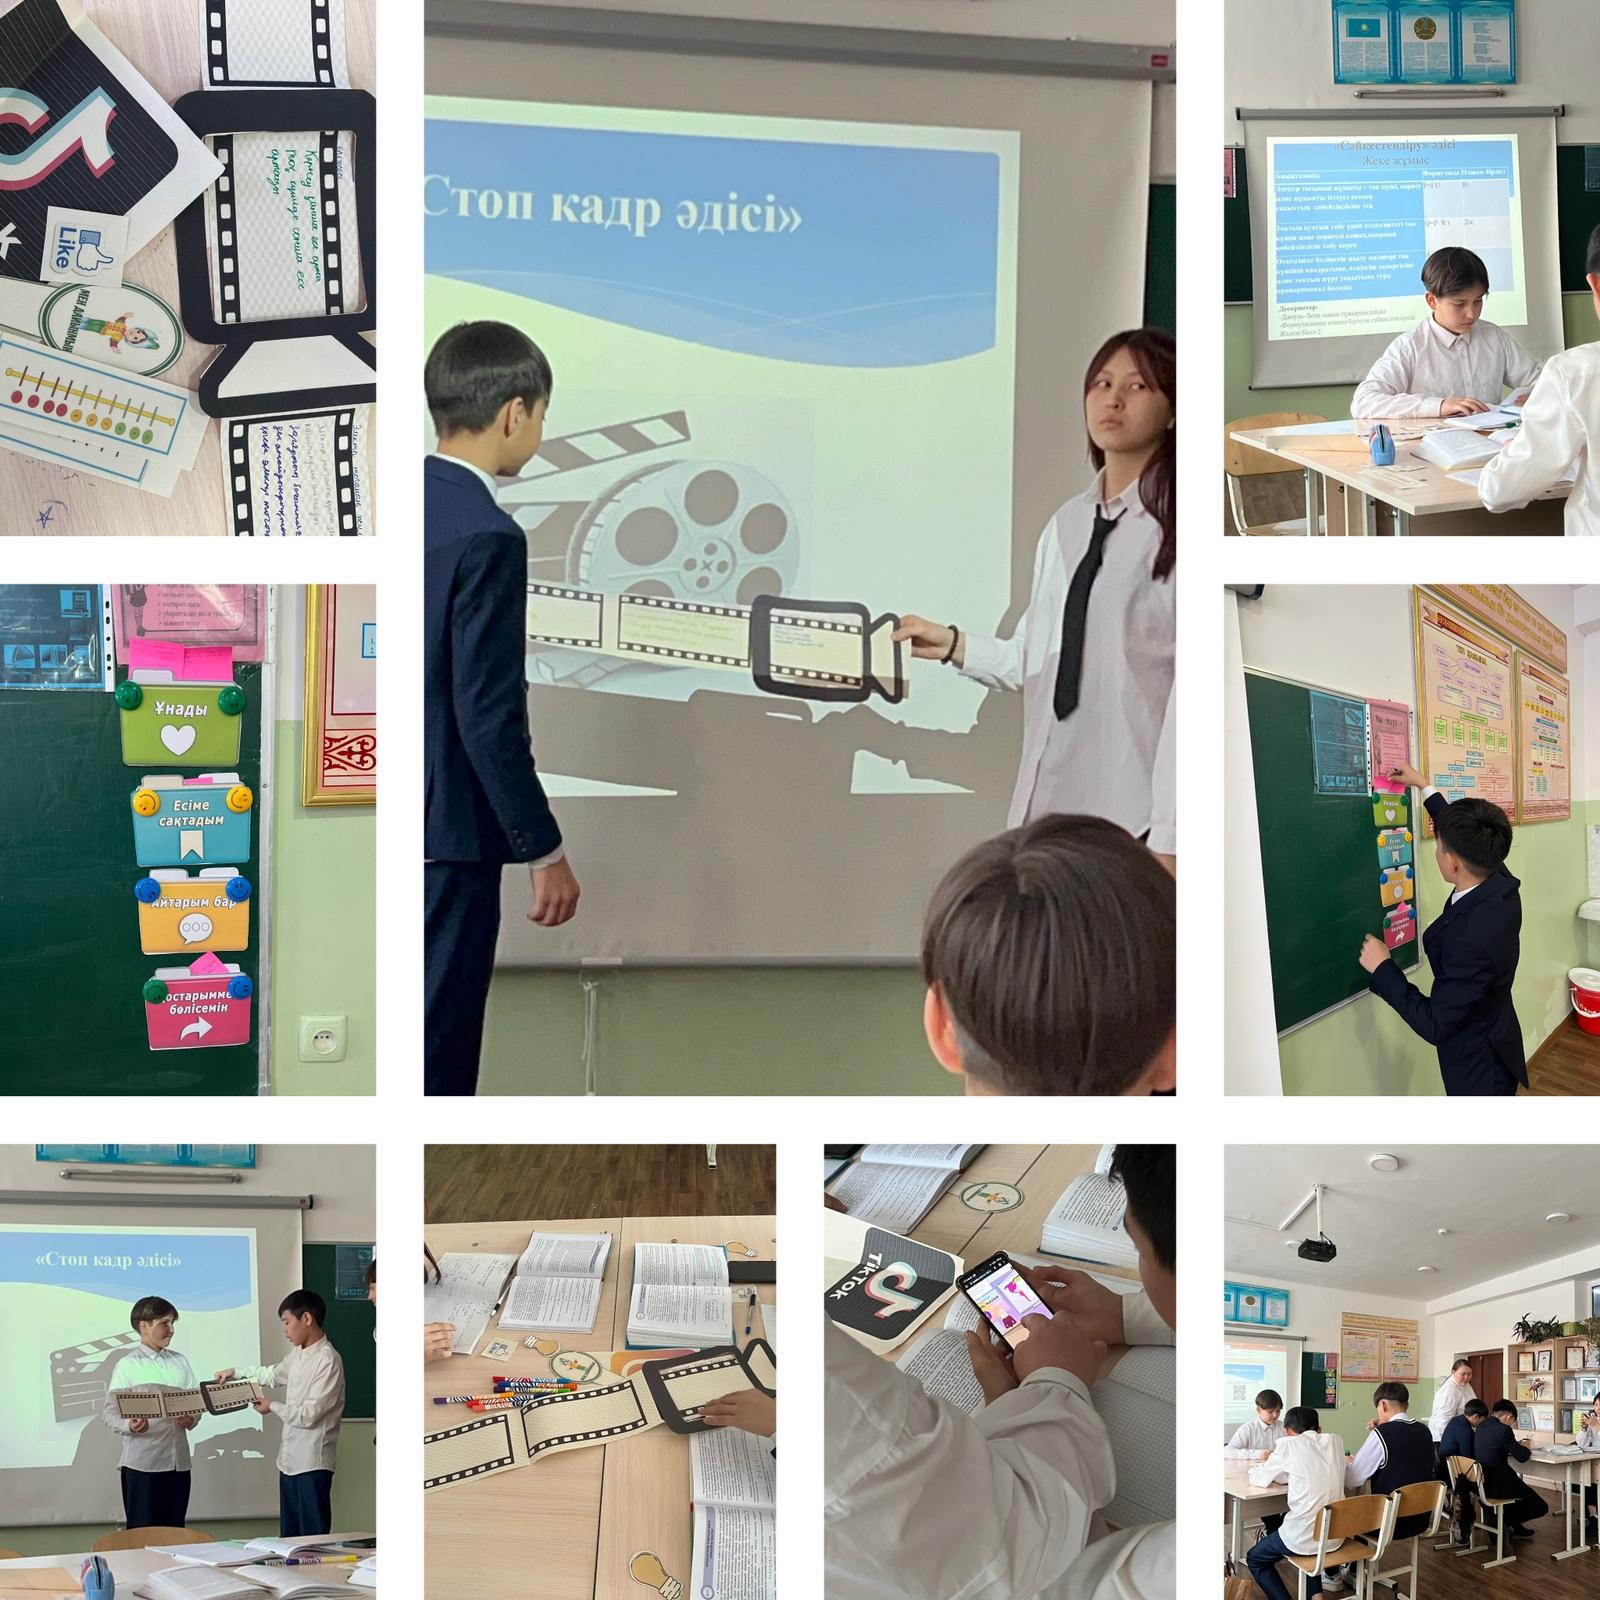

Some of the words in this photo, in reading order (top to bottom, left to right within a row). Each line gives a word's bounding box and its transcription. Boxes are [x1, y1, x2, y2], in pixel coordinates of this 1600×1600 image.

[1361, 156, 1390, 166] Жеке
[424, 174, 534, 220] Стоп
[551, 193, 661, 237] кадр
[675, 191, 803, 236] әдісі»
[56, 226, 77, 268] Like
[77, 289, 90, 307] МЕН
[155, 701, 208, 717] Ұнады
[173, 799, 210, 811] Есіме
[159, 815, 225, 828] сақтадым
[151, 896, 209, 910] Айтарым
[214, 896, 237, 909] бар
[162, 990, 232, 1003] остарымме
[169, 1002, 228, 1015] бөлісемін
[36, 1251, 88, 1266] «Стоп
[93, 1255, 132, 1270] кадр
[136, 1252, 182, 1267] әдісі»
